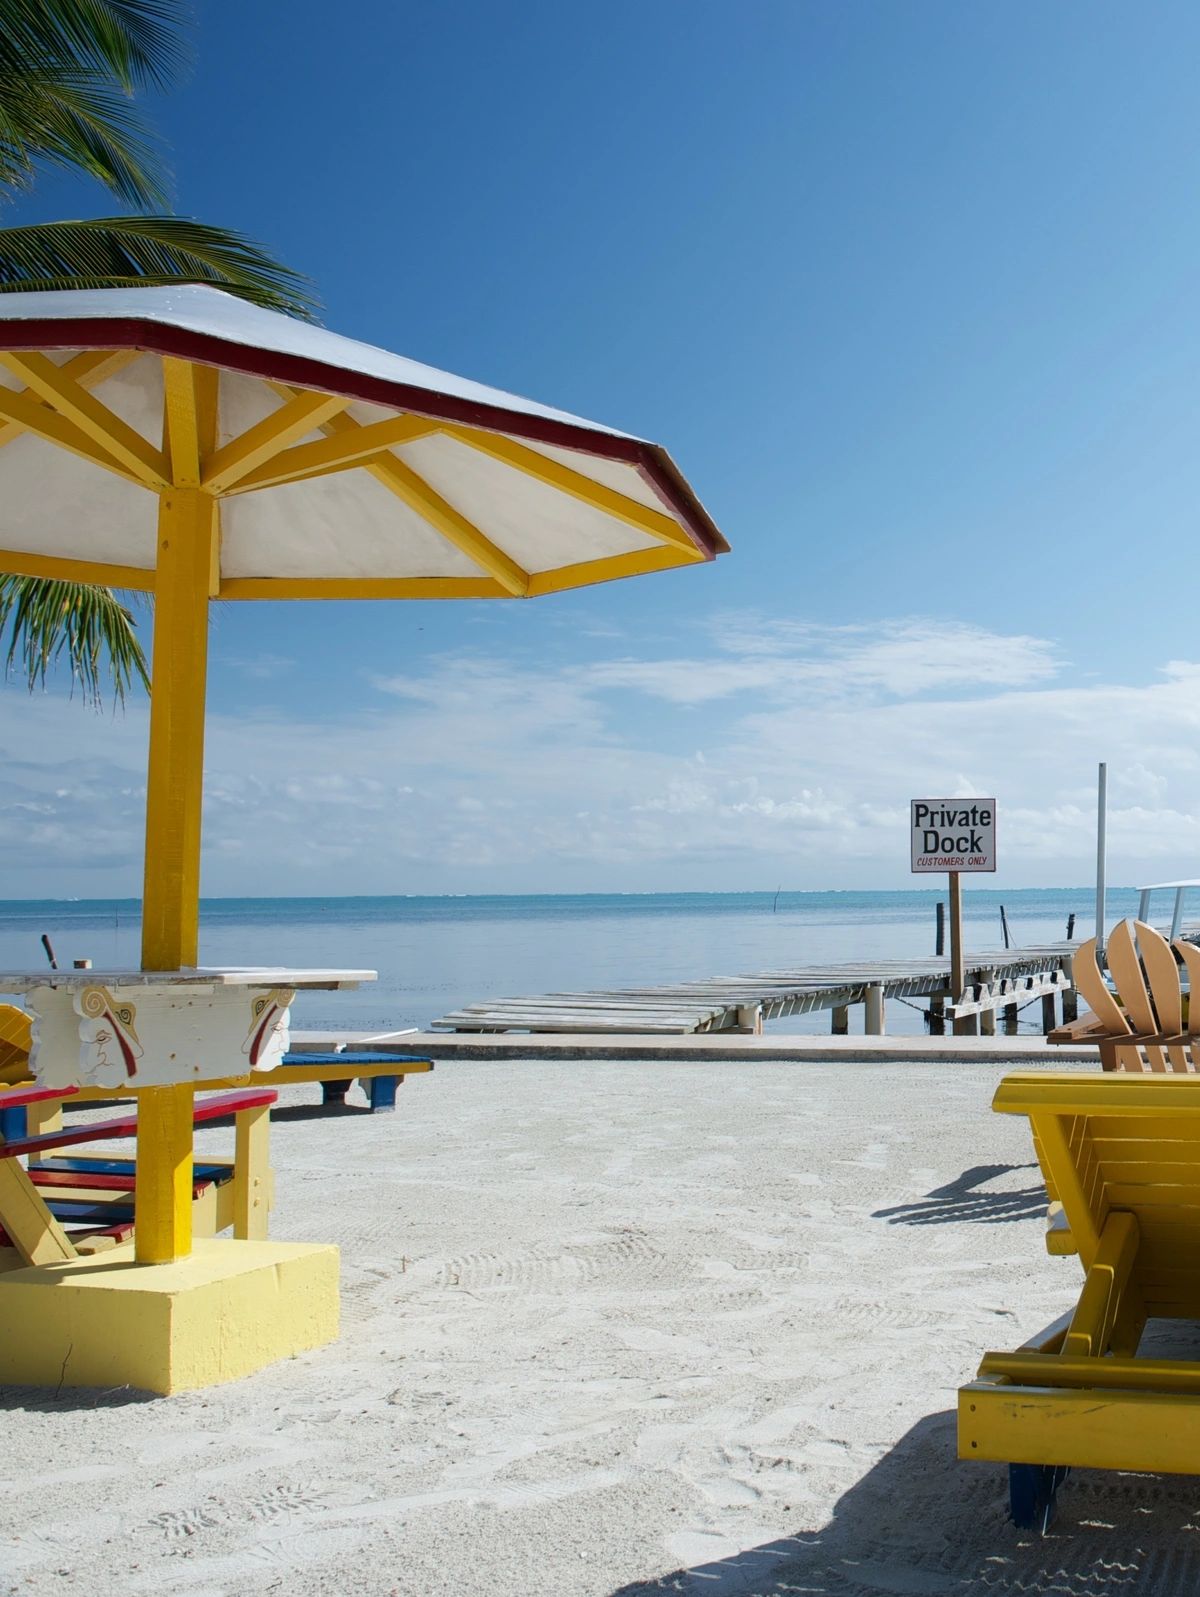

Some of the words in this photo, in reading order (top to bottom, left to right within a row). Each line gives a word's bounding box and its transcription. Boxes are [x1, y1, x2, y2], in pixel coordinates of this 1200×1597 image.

[914, 803, 992, 828] Private
[923, 829, 983, 854] Dock
[916, 856, 965, 867] CUSTOMERS
[967, 856, 988, 866] ONLY
